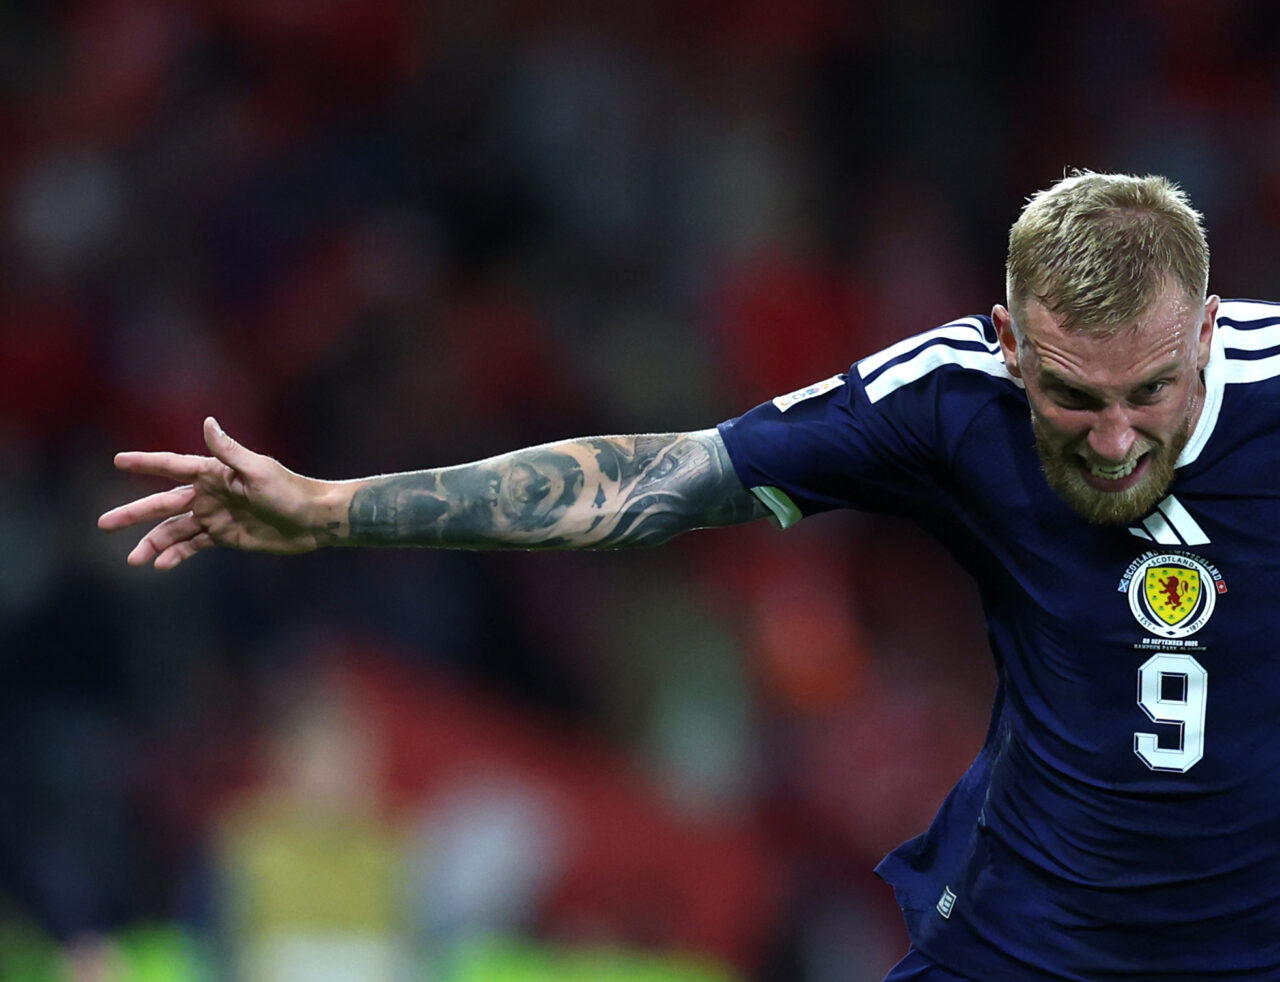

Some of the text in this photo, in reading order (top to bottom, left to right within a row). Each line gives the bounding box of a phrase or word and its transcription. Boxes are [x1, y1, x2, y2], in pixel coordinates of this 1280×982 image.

[1123, 550, 1158, 580] SCOTLAND
[1151, 556, 1195, 568] SCOTLAND
[1140, 617, 1152, 628] EST
[1133, 652, 1208, 773] 9
